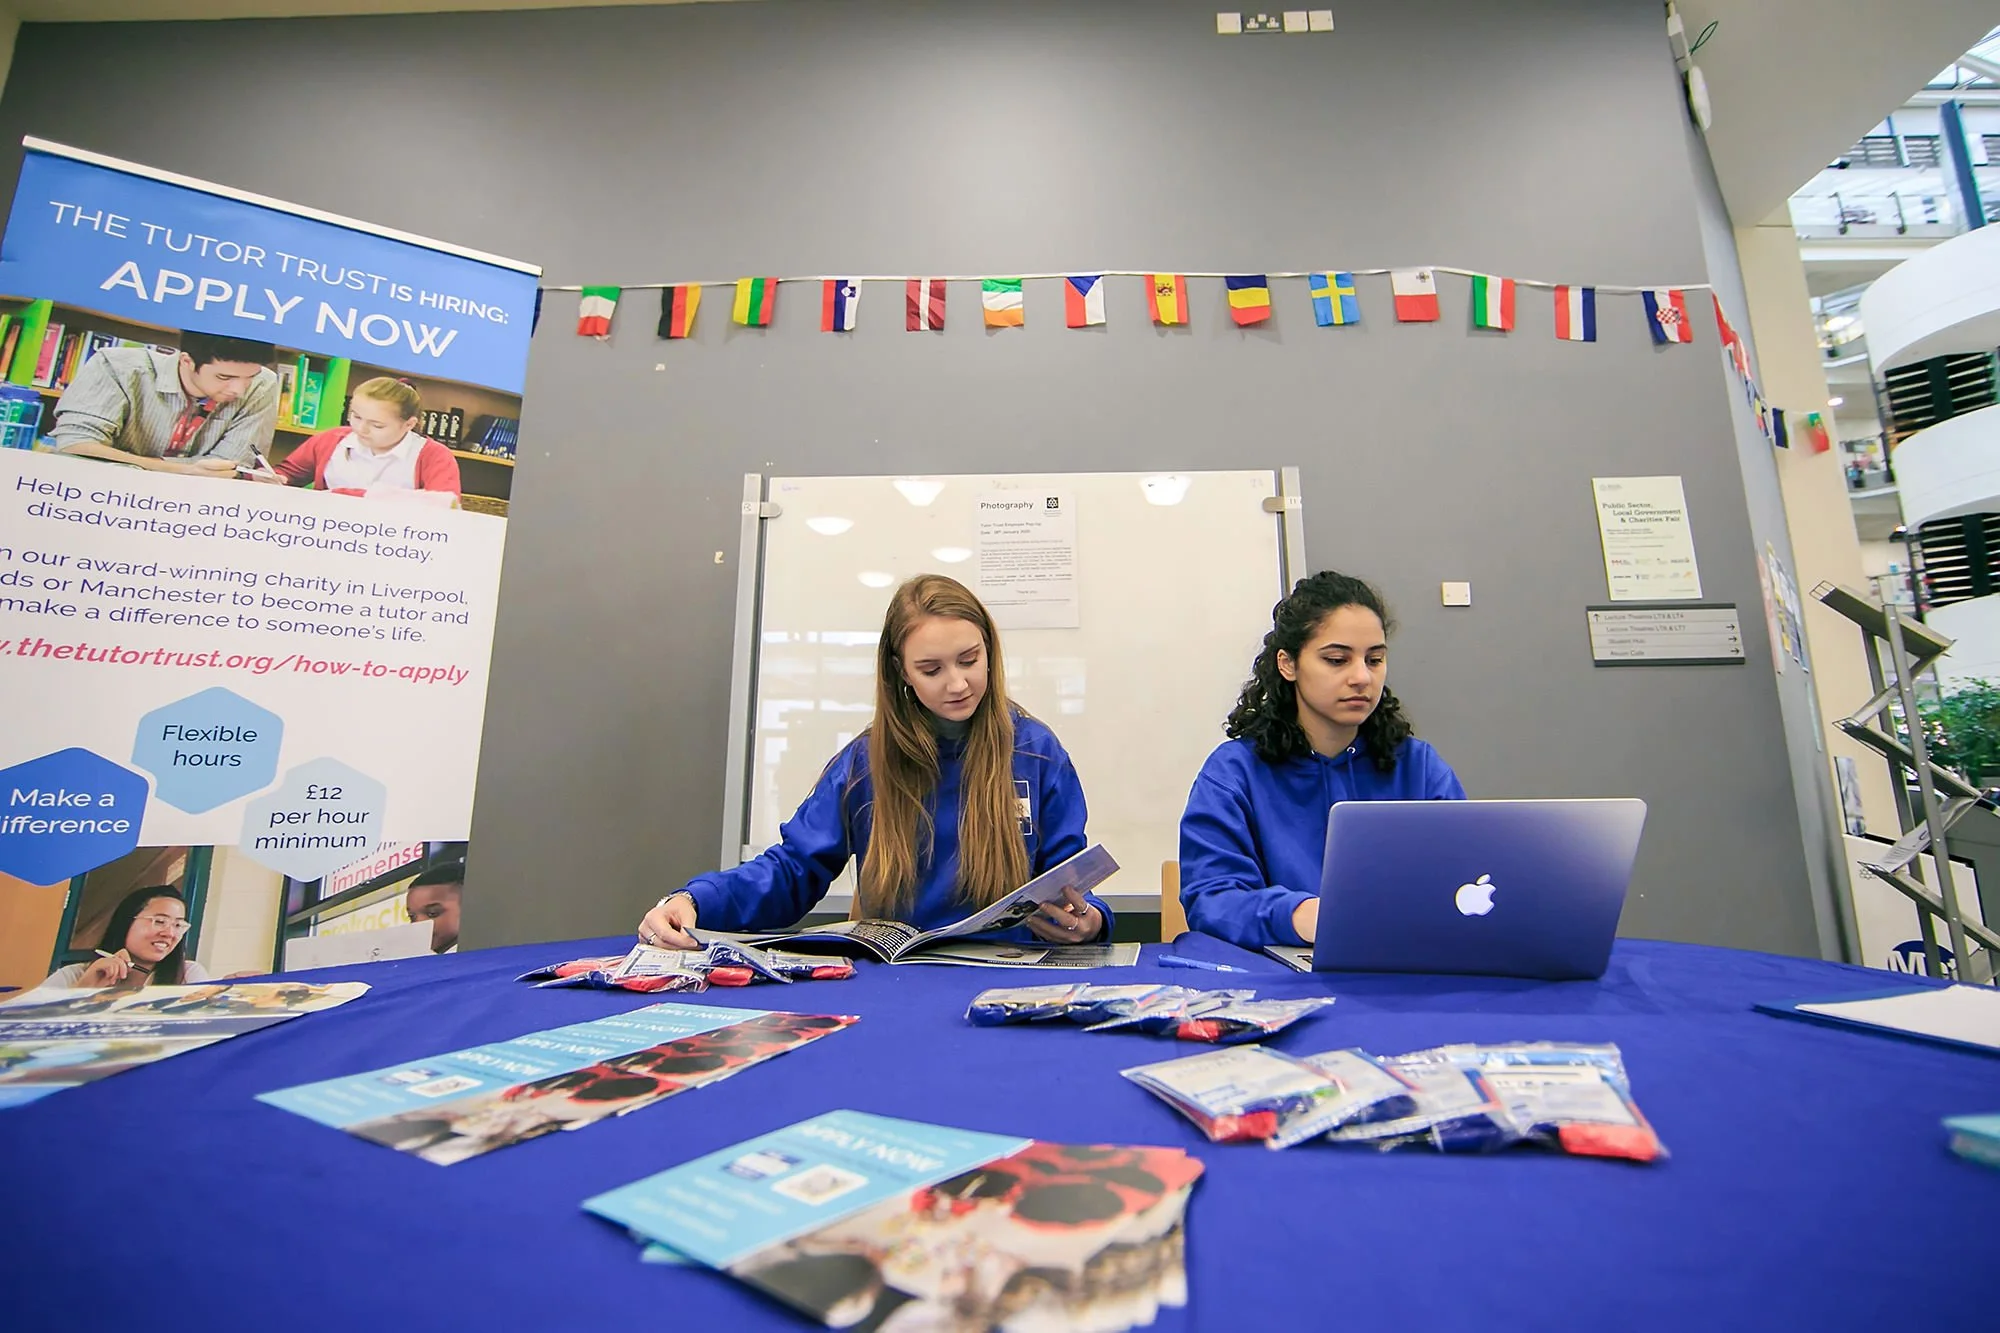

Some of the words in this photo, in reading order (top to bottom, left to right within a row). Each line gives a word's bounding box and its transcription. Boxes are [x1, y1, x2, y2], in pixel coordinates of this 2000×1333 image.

[50, 201, 130, 239] THE
[141, 222, 266, 268] TUTOR
[276, 251, 388, 295] TRUST
[389, 282, 413, 302] IS
[419, 289, 511, 326] HIRING:
[99, 260, 305, 326] APPLY
[315, 301, 459, 358] NOW
[16, 474, 82, 502] Help
[91, 489, 193, 514] children
[198, 503, 241, 518] and
[246, 508, 316, 531] young
[322, 519, 397, 538] people
[403, 525, 448, 543] from
[980, 502, 1034, 510] Photography
[1627, 502, 1654, 510] Sector,
[1633, 508, 1681, 516] Government
[1628, 516, 1663, 524] Charities
[26, 501, 217, 539] disadvantaged
[223, 523, 368, 554] backgrounds
[375, 542, 433, 564] today.
[22, 551, 72, 568] our
[77, 557, 258, 588] award-winning
[264, 572, 342, 597] charity
[346, 579, 365, 596] in
[371, 583, 469, 607] Liverpool,
[43, 578, 73, 592] or
[80, 578, 227, 606] Manchester
[232, 591, 254, 608] to
[261, 592, 354, 616] become
[359, 606, 372, 617] a
[378, 604, 427, 621] tutor
[431, 611, 469, 625] and
[0, 598, 77, 617] make
[85, 607, 100, 620] a
[108, 606, 230, 629] difference
[237, 613, 260, 630] to
[265, 620, 385, 641] someone's
[391, 626, 427, 643] life.
[161, 724, 258, 744] Flexible
[172, 749, 243, 768] hours
[10, 788, 92, 807] Make
[98, 793, 116, 807] a
[305, 784, 343, 801] £12
[0, 815, 130, 834] ifference
[269, 809, 313, 829] per
[316, 808, 370, 825] hour
[254, 831, 367, 850] minimum
[332, 841, 424, 894] immense
[863, 1140, 946, 1173] NOW
